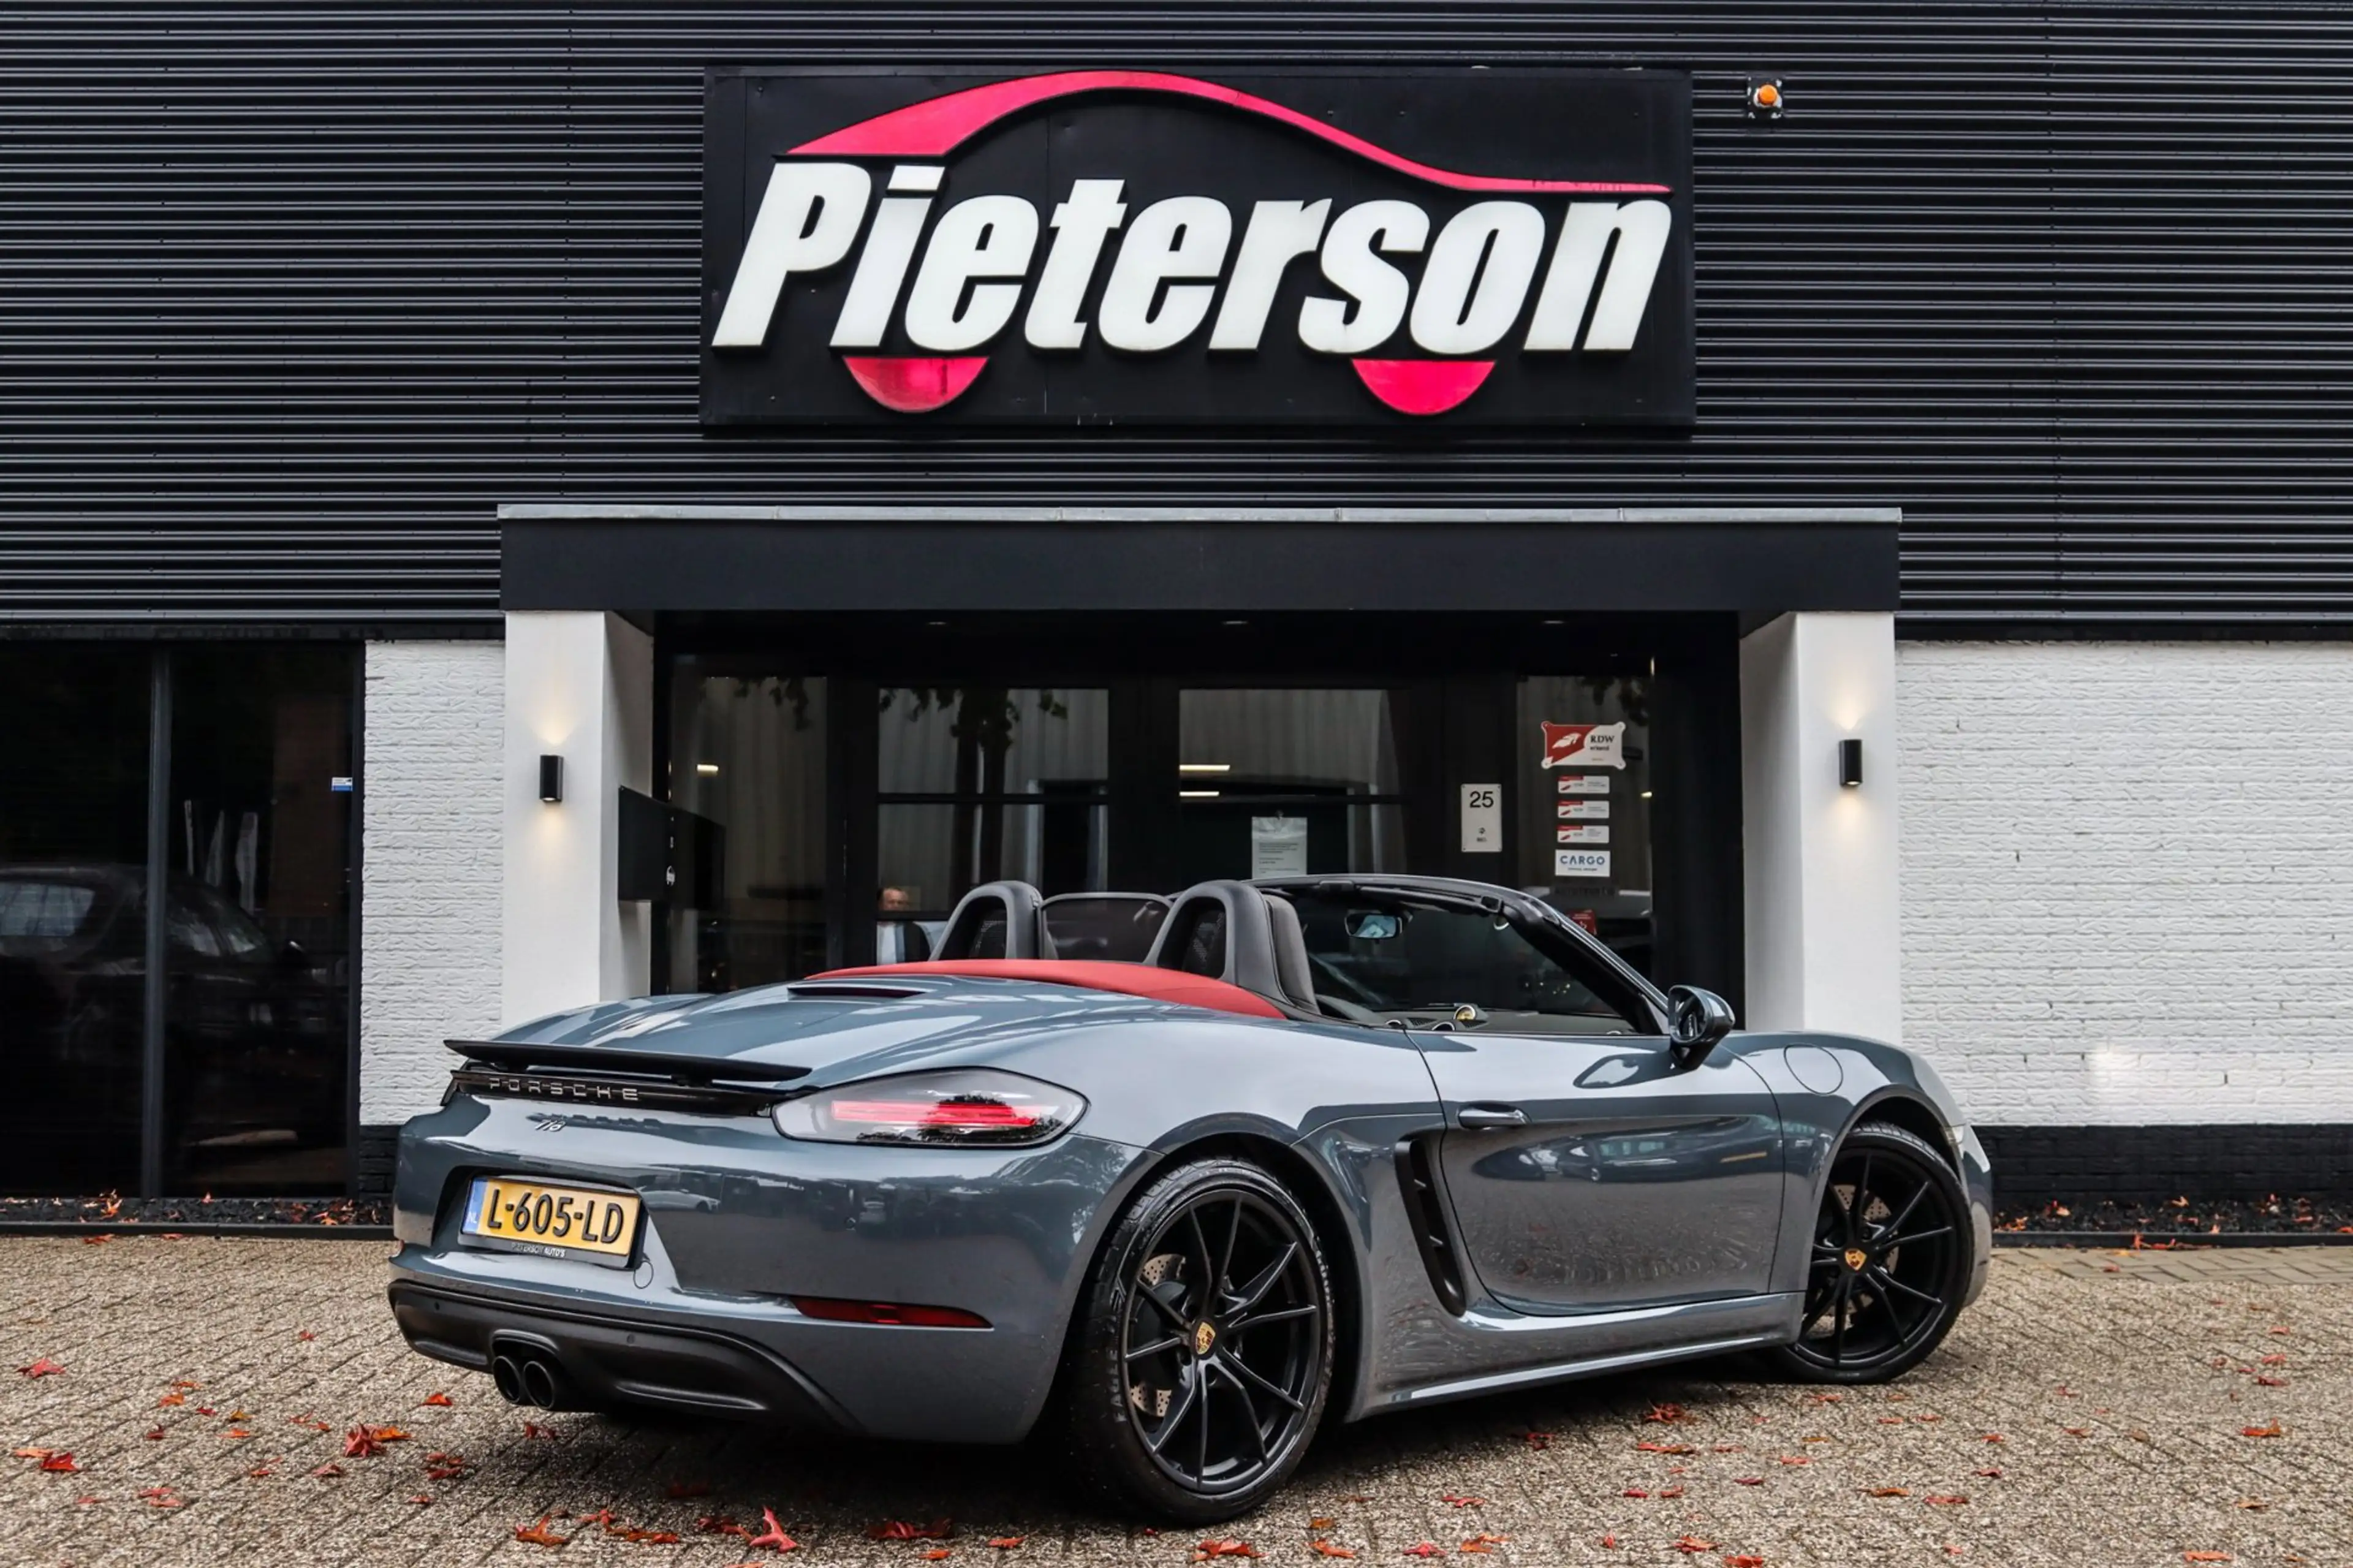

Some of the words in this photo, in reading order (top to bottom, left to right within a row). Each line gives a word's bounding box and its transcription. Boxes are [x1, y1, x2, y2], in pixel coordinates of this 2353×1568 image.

[712, 162, 1673, 355] Pieterson
[1469, 790, 1494, 808] 25
[1560, 855, 1605, 865] CARGO
[489, 1077, 638, 1101] PORSCHE
[466, 1211, 477, 1224] NL
[487, 1189, 624, 1244] L-605-LD
